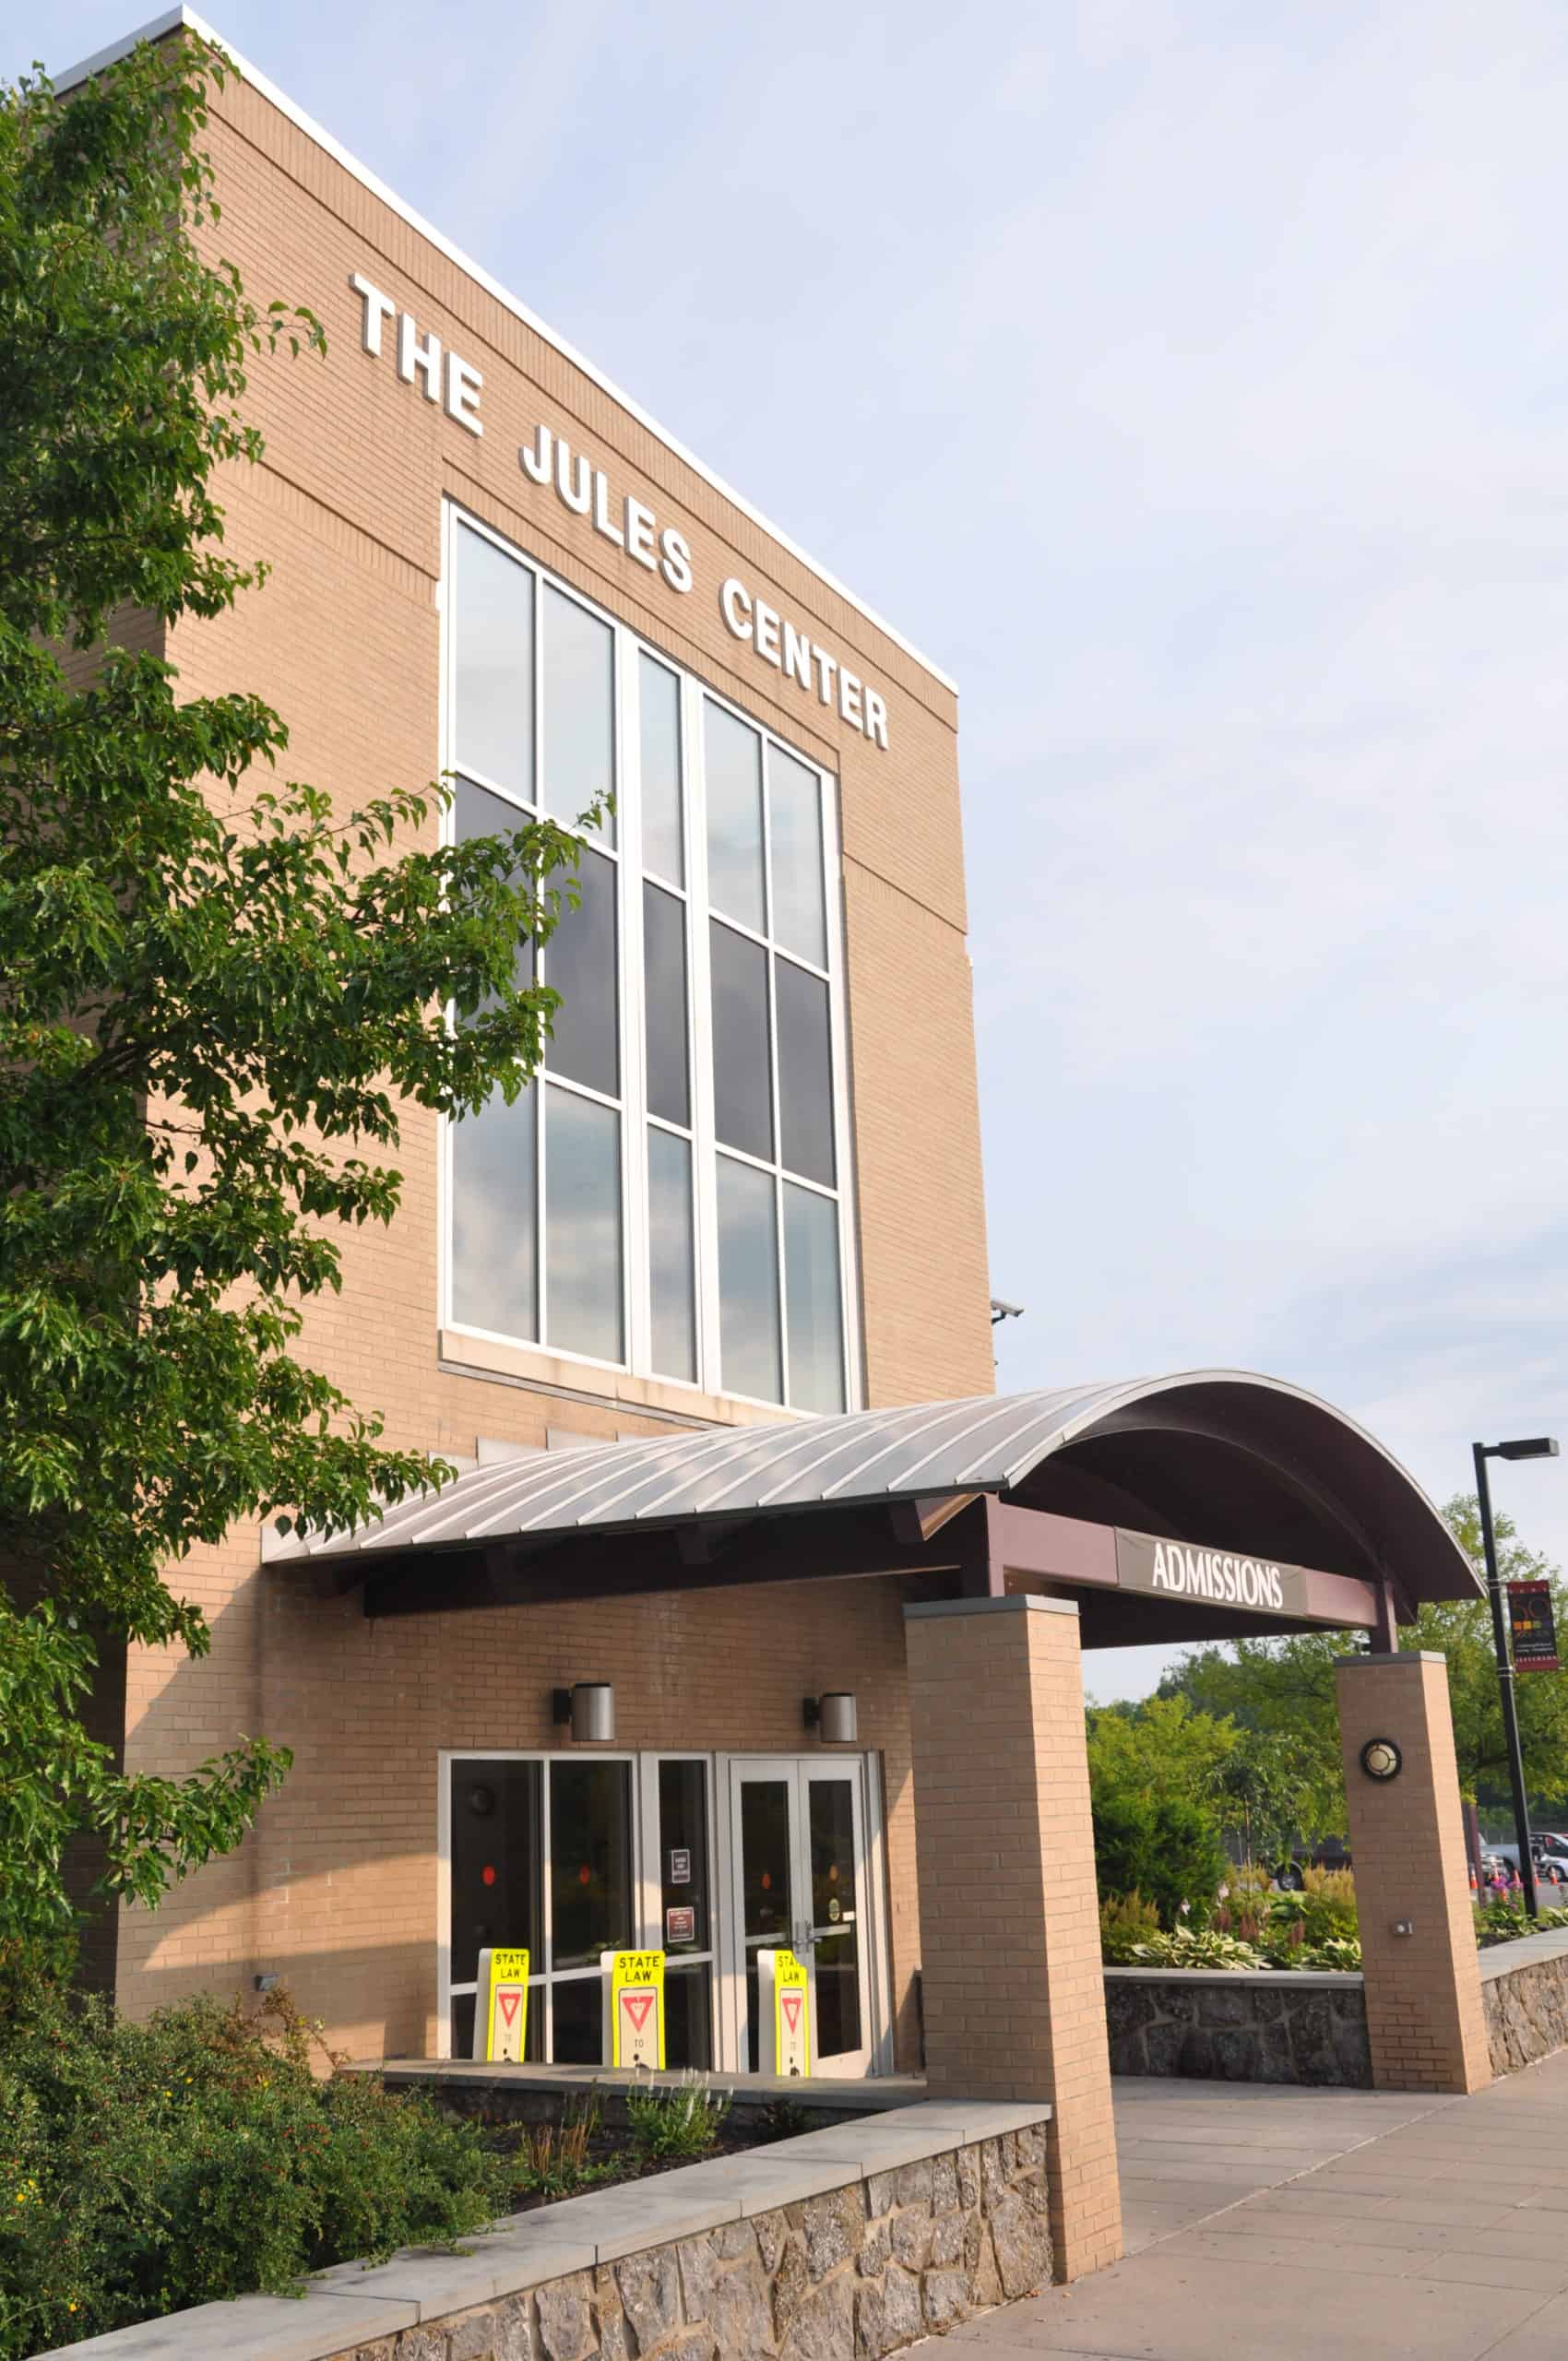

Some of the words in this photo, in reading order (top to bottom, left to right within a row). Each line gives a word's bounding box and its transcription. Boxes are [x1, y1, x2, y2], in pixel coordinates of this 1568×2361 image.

[350, 272, 483, 437] THE
[519, 424, 694, 593] JULES
[719, 578, 890, 750] CENTER
[1152, 1541, 1284, 1609] ADMISSIONS
[495, 1953, 526, 1965] STATE
[619, 1955, 660, 1969] STATE
[778, 1955, 799, 1968] STA
[501, 1968, 521, 1978] LAW
[625, 1971, 652, 1983] LAW
[782, 1972, 800, 1983] LAW
[635, 2038, 645, 2048] TO
